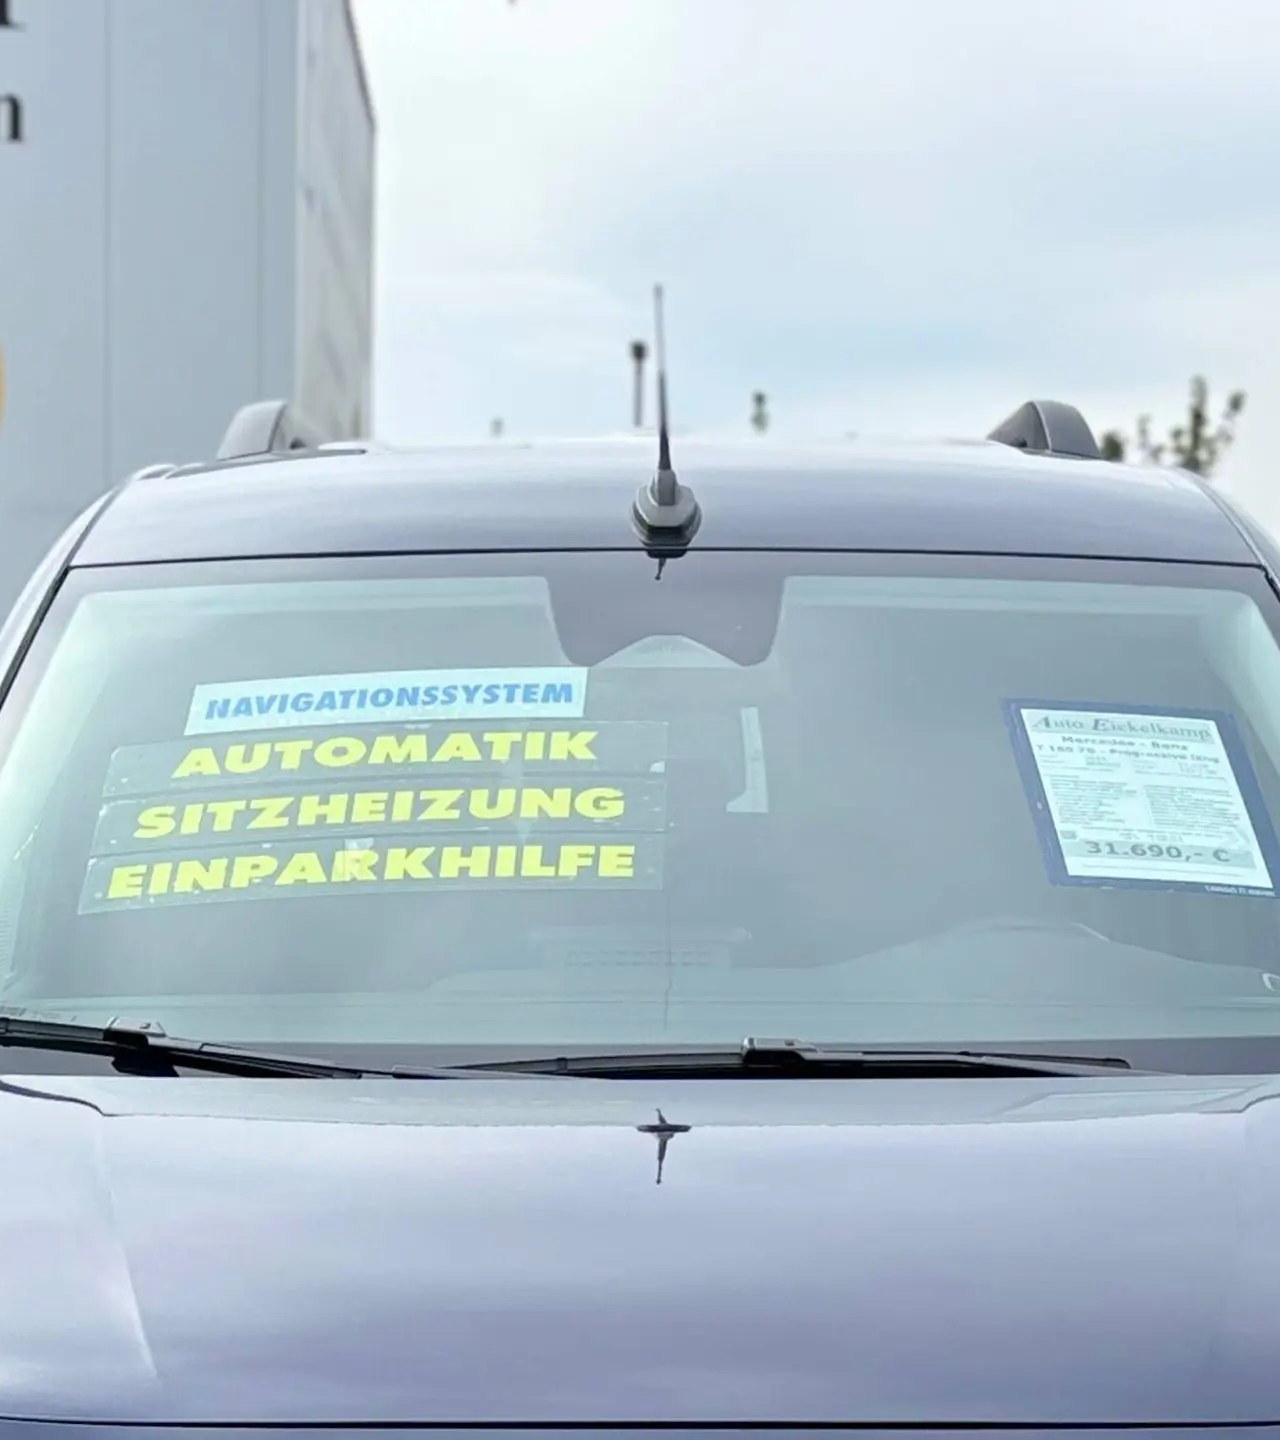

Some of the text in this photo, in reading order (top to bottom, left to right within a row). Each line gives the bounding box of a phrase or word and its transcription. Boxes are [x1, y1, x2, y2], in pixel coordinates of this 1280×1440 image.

[205, 682, 573, 720] NAVIGATIONSSYSTEM
[1031, 716, 1212, 740] Auto Eickelkamp
[172, 730, 599, 779] AUTOMATIK
[133, 786, 625, 839] SITZHEIZUNG
[107, 844, 636, 899] EINPARKHILFE
[1085, 840, 1203, 862] 31.690,-
